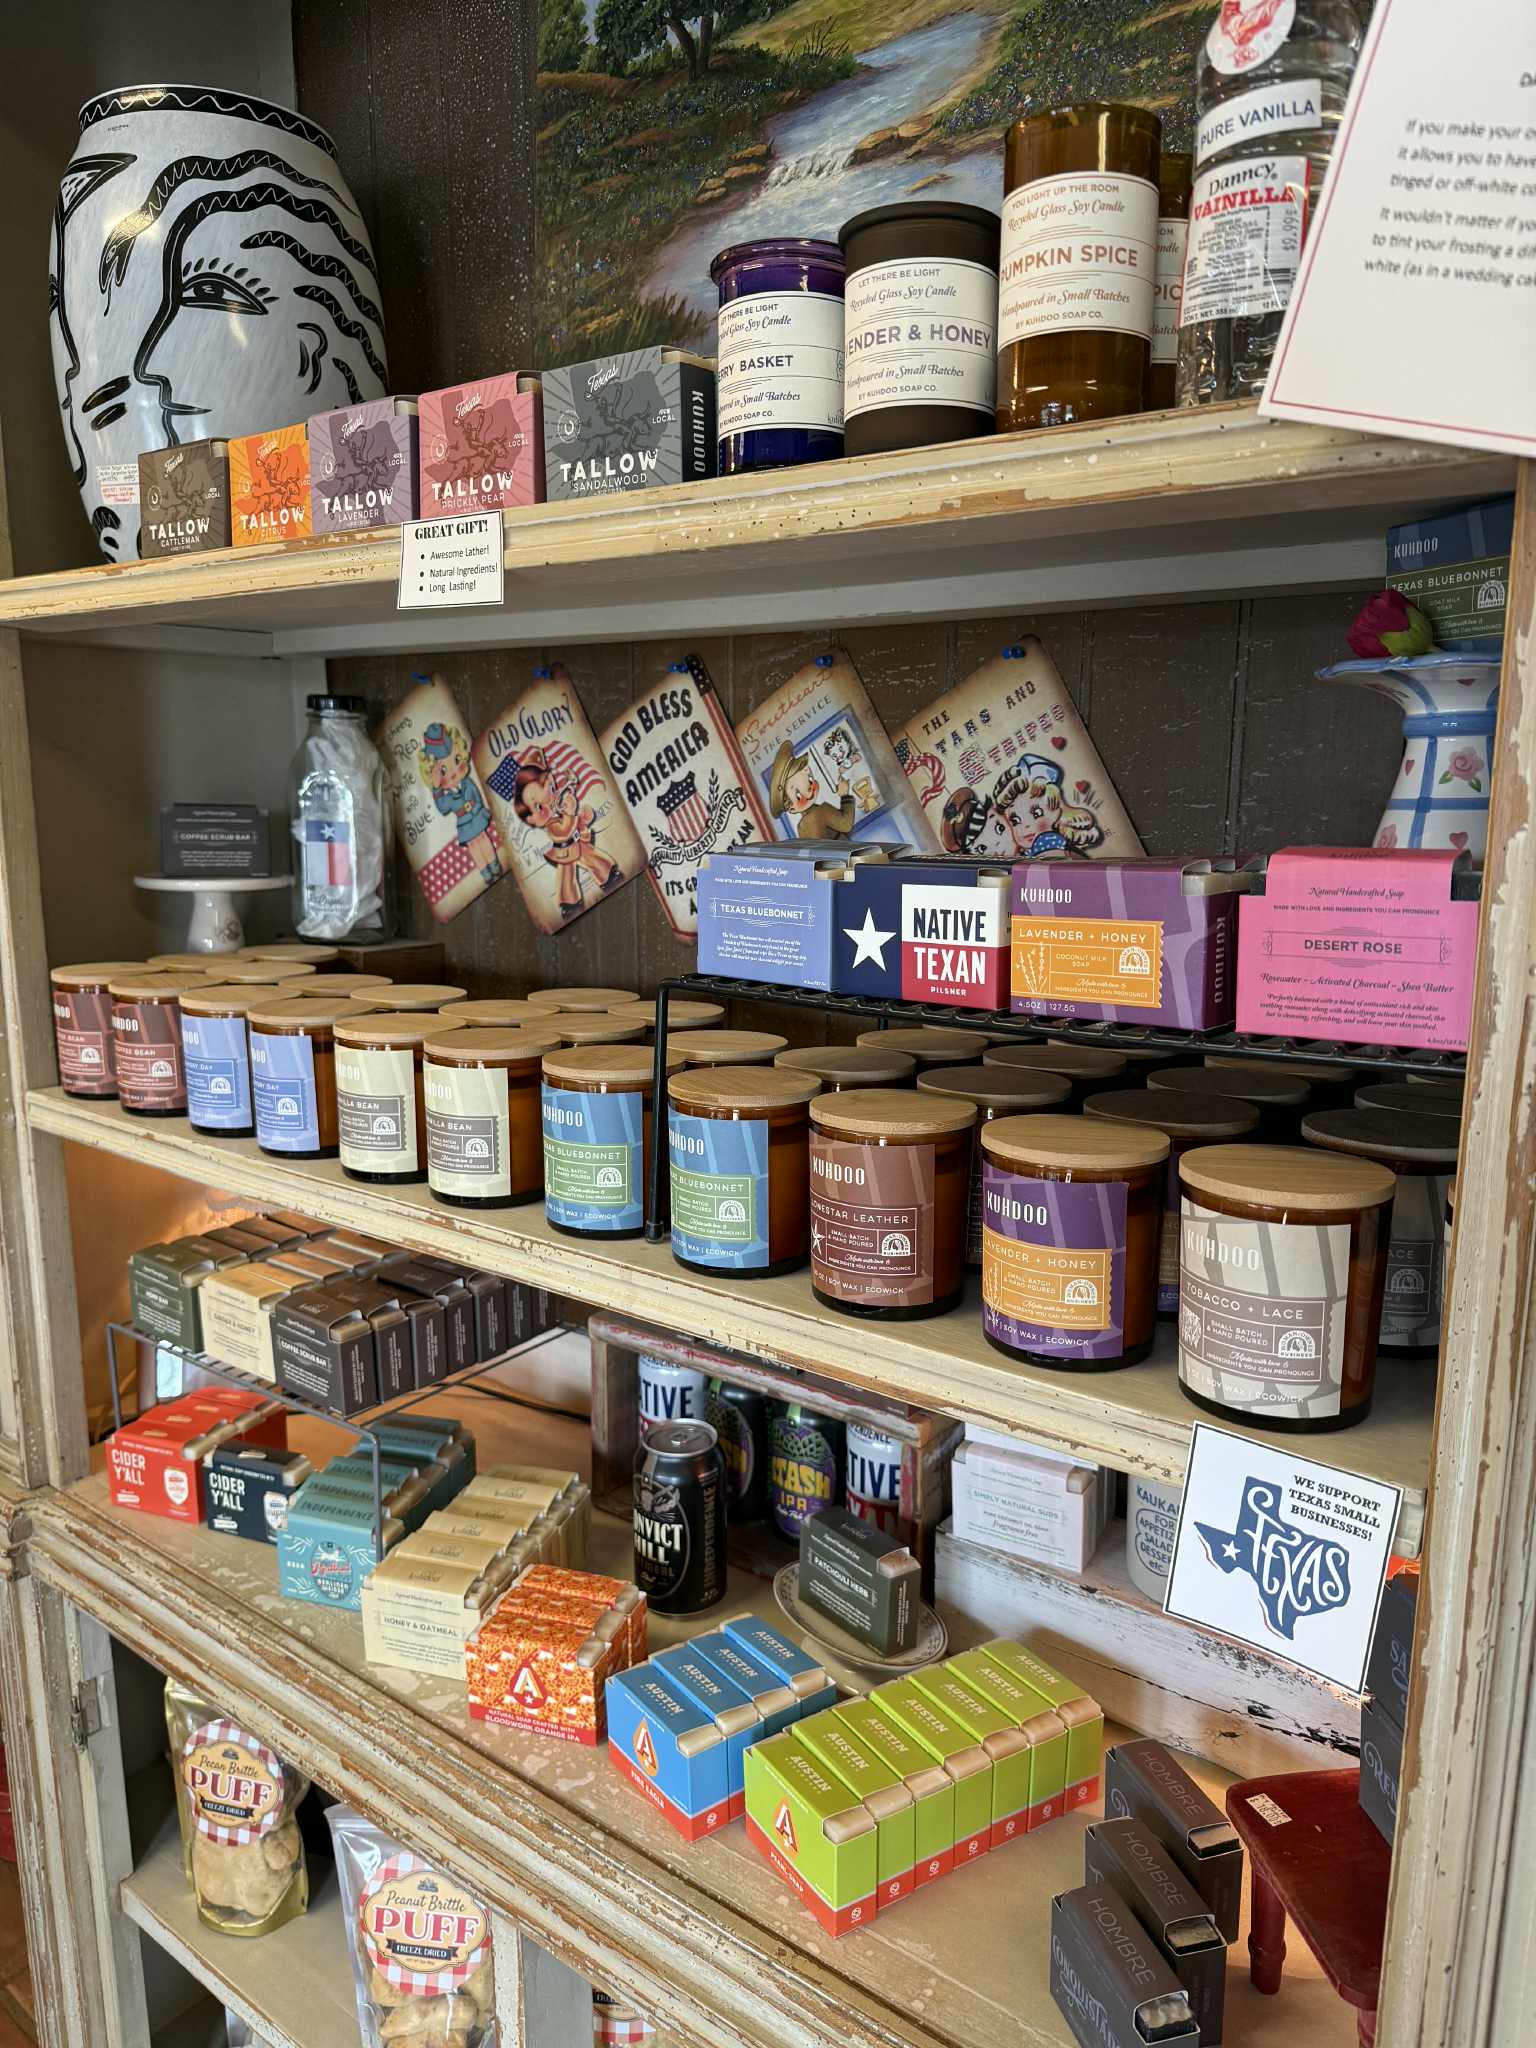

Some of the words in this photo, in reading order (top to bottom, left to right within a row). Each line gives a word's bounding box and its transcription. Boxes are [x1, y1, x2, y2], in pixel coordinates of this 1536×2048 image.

[1200, 118, 1235, 151] PURE
[1239, 99, 1315, 128] VANILLA
[1091, 183, 1120, 194] ROOM
[1209, 161, 1277, 197] Danncy
[1454, 177, 1518, 195] off-white
[1091, 199, 1126, 215] Candle
[1193, 186, 1297, 222] VAINILLA
[1393, 210, 1453, 226] wouldn't
[1455, 212, 1502, 230] matter
[1449, 238, 1502, 259] frosting
[872, 272, 897, 284] THERE
[1000, 246, 1072, 288] PUMPKIN
[1080, 245, 1138, 267] SPICE
[1364, 258, 1401, 275] white
[1454, 269, 1512, 288] wedding
[925, 286, 957, 298] Candle
[1057, 288, 1092, 305] Small
[1093, 288, 1131, 303] Batches
[762, 315, 792, 329] Candle
[1025, 313, 1060, 328] KUHDOO
[1062, 311, 1087, 320] SOAP
[930, 323, 992, 350] HONEY
[740, 355, 794, 372] BASKET
[928, 364, 965, 377] Batches
[588, 364, 619, 393] Texas
[455, 393, 481, 418] Texas
[765, 391, 800, 402] Batches
[341, 414, 364, 438] Texas
[652, 415, 677, 425] LOCAL
[691, 390, 707, 473] KUHDOO
[257, 439, 278, 465] Texas
[508, 438, 529, 448] LOCAL
[164, 453, 184, 478] Texas
[560, 448, 659, 483] TALLOW
[432, 470, 513, 500] TALLOW
[573, 473, 648, 493] SANDALWOOD
[322, 487, 394, 515] TALLOW
[481, 492, 505, 504] PEAR
[240, 505, 305, 531] TALLOW
[338, 510, 379, 523] LAVENDER
[150, 518, 210, 541] TALLOW
[261, 527, 287, 538] CITRUS
[415, 524, 454, 541] GREAT
[456, 519, 489, 536] GIFT!
[161, 536, 200, 549] CATTLEMAN
[430, 551, 464, 561] Awesome
[465, 545, 490, 557] Lather!
[1394, 537, 1439, 558] KUHDOO
[430, 567, 455, 578] Natural
[457, 562, 498, 578] Ingredients!
[1392, 580, 1423, 593] TEXAS
[1428, 566, 1504, 588] BLUEBONNET
[429, 583, 446, 594] Long
[449, 580, 477, 592] Lasting!
[1005, 680, 1038, 710] AND
[747, 668, 833, 755] Sweetheart
[922, 710, 951, 737] THE
[488, 723, 520, 758] OLD
[519, 702, 575, 740] GLORY
[609, 720, 642, 775] GOD
[636, 688, 693, 735] BLESS
[763, 738, 782, 757] THE
[786, 694, 832, 737] SERVICE
[626, 721, 710, 807] AMERICA
[180, 833, 208, 842] COFFEE
[210, 833, 234, 842] SCRUB
[235, 834, 251, 842] BAR
[686, 832, 715, 860] LIBERTY
[714, 794, 734, 832] JUSTICE
[1019, 887, 1072, 904] KUHDOO
[720, 903, 746, 914] TEXAS
[747, 904, 804, 920] BLUEBONNET
[913, 907, 987, 942] NATIVE
[1019, 927, 1083, 942] LAVENDER
[1101, 931, 1147, 944] HONEY
[1055, 953, 1090, 962] COCONUT
[1304, 939, 1359, 953] DESERT
[1363, 942, 1403, 955] ROSE
[913, 946, 986, 985] TEXAN
[1213, 916, 1226, 1004] KUHDOO
[930, 986, 967, 997] PILSNER
[1260, 972, 1302, 985] Rosewater
[1310, 975, 1351, 988] Activated
[1352, 977, 1390, 990] Charcoal
[356, 1101, 380, 1111] BEAN
[447, 1122, 472, 1132] BEAN
[557, 1147, 621, 1161] BLUEBONNET
[812, 1155, 866, 1187] KUHDOO
[679, 1176, 744, 1193] BLUEBONNET
[853, 1213, 910, 1225] LEATHER
[986, 1189, 1048, 1227] KUHDOO
[1186, 1229, 1260, 1271] KUHDOO
[1048, 1258, 1098, 1270] HONEY
[865, 1286, 905, 1295] ECOWICK
[1186, 1282, 1241, 1312] TOBACCO
[1262, 1308, 1304, 1320] LACE
[1019, 1330, 1037, 1341] WAX
[1045, 1336, 1090, 1346] ECOWICK
[1211, 1319, 1234, 1332] SMALL
[1235, 1326, 1263, 1338] BATCH
[1235, 1334, 1269, 1346] POURED
[112, 1449, 146, 1471] CIDER
[114, 1466, 145, 1486] Y'ALL
[209, 1473, 246, 1496] CIDER
[850, 1451, 902, 1501] TIVE
[211, 1488, 244, 1512] Y'ALL
[780, 1491, 808, 1511] IPA
[973, 1490, 999, 1504] SIMPLY
[1294, 1474, 1316, 1490] WE
[1317, 1483, 1381, 1512] SUPPORT
[301, 1499, 375, 1522] INDEPENDENCE
[1289, 1488, 1332, 1511] TEXAS
[1334, 1503, 1381, 1529] SMALL
[1154, 1514, 1175, 1531] FOR
[1290, 1504, 1374, 1542] BUSINESSES!
[813, 1555, 850, 1586] PATCHOULI
[849, 1582, 870, 1600] HERB
[384, 1616, 411, 1630] HONEY
[420, 1623, 460, 1638] OATMEAL
[756, 1630, 795, 1659] AUSTIN
[720, 1647, 759, 1678] AUSTIN
[1016, 1653, 1060, 1684] AUSTIN
[513, 1667, 544, 1700] A
[683, 1663, 723, 1695] AUSTIN
[979, 1666, 1023, 1699] AUSTIN
[645, 1681, 685, 1714] AUSTIN
[943, 1682, 988, 1714] AUSTIN
[484, 1714, 534, 1732] BLOODWORK
[535, 1725, 566, 1739] ORANGE
[905, 1698, 949, 1734] AUSTIN
[867, 1716, 909, 1753] AUSTIN
[828, 1731, 869, 1770] AUSTIN
[200, 1755, 225, 1771] Pecan
[228, 1761, 259, 1778] Brittle
[790, 1753, 832, 1793] AUSTIN
[189, 1766, 273, 1809] PUFF
[631, 1769, 645, 1791] FIRE
[645, 1783, 665, 1809] EAGLE
[1139, 1751, 1206, 1818] HOMBRE
[1121, 1830, 1188, 1908] HOMBRE
[385, 1890, 426, 1909] Peanut
[427, 1895, 466, 1914] Brittle
[373, 1905, 480, 1945] PUFF
[396, 1943, 422, 1954] FREEZE
[423, 1947, 447, 1959] DRIED
[1087, 1896, 1157, 1986] HOMBRE
